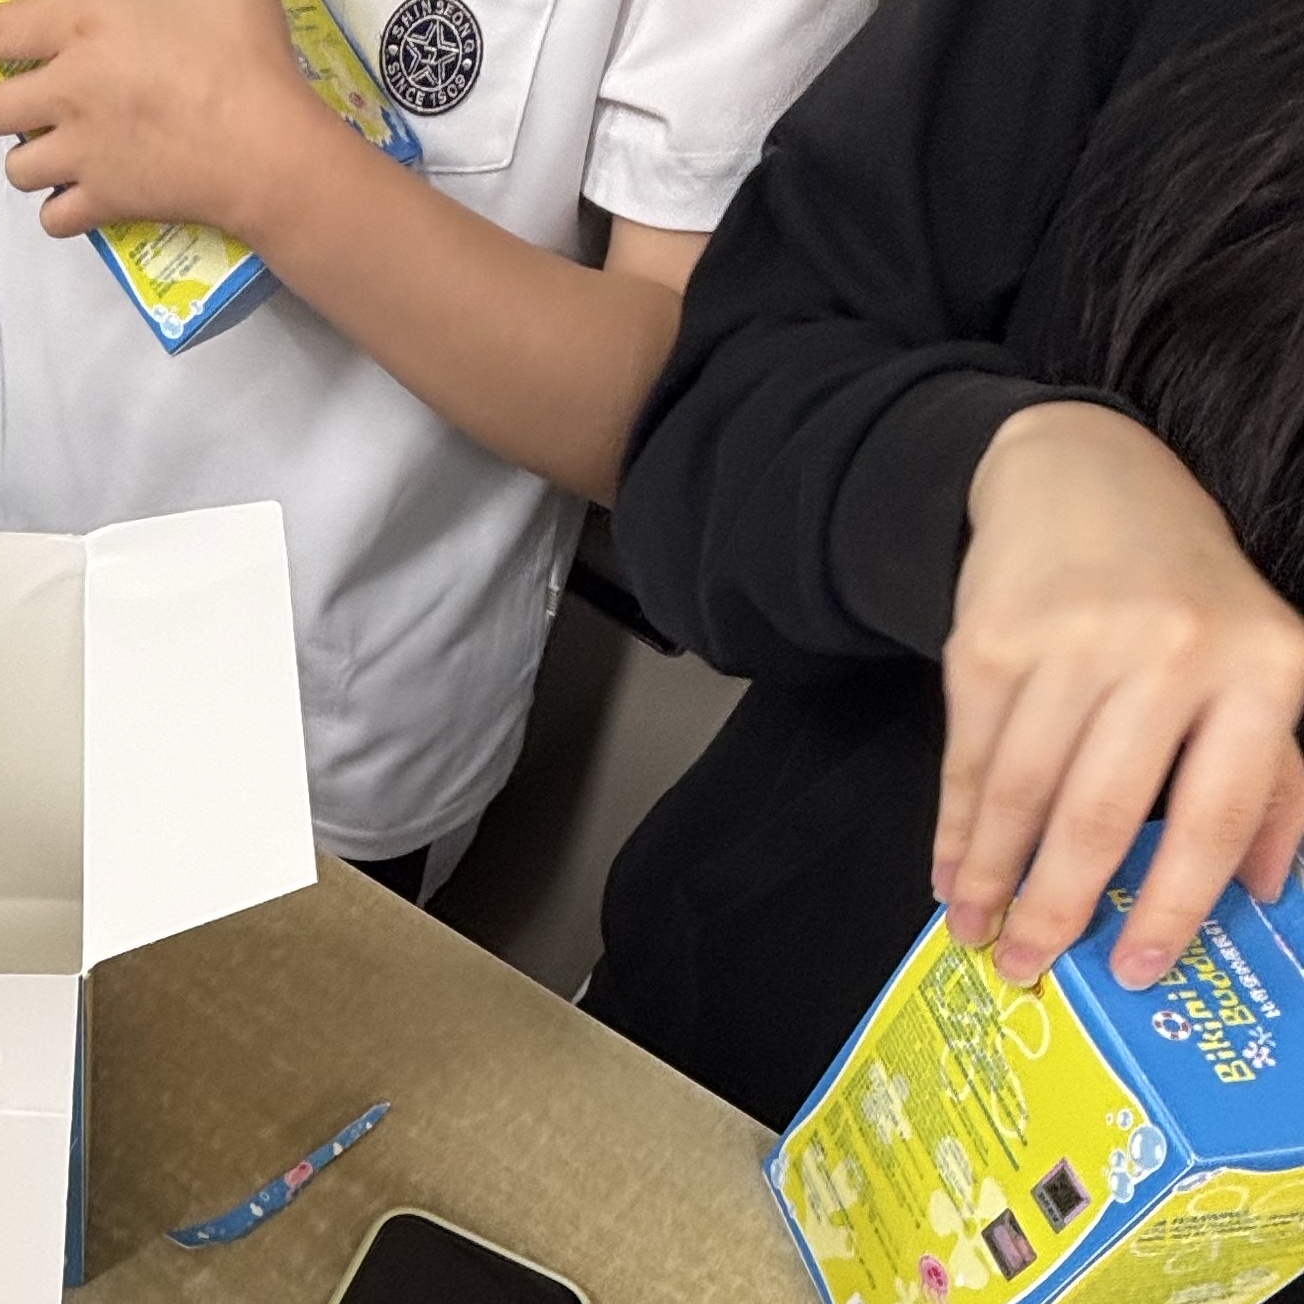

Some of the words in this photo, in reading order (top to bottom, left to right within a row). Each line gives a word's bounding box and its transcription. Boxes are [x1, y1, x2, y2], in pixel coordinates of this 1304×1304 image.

[388, 61, 426, 106] SINCE
[1181, 936, 1257, 1026] Buddi
[1167, 990, 1257, 1083] Bikini
